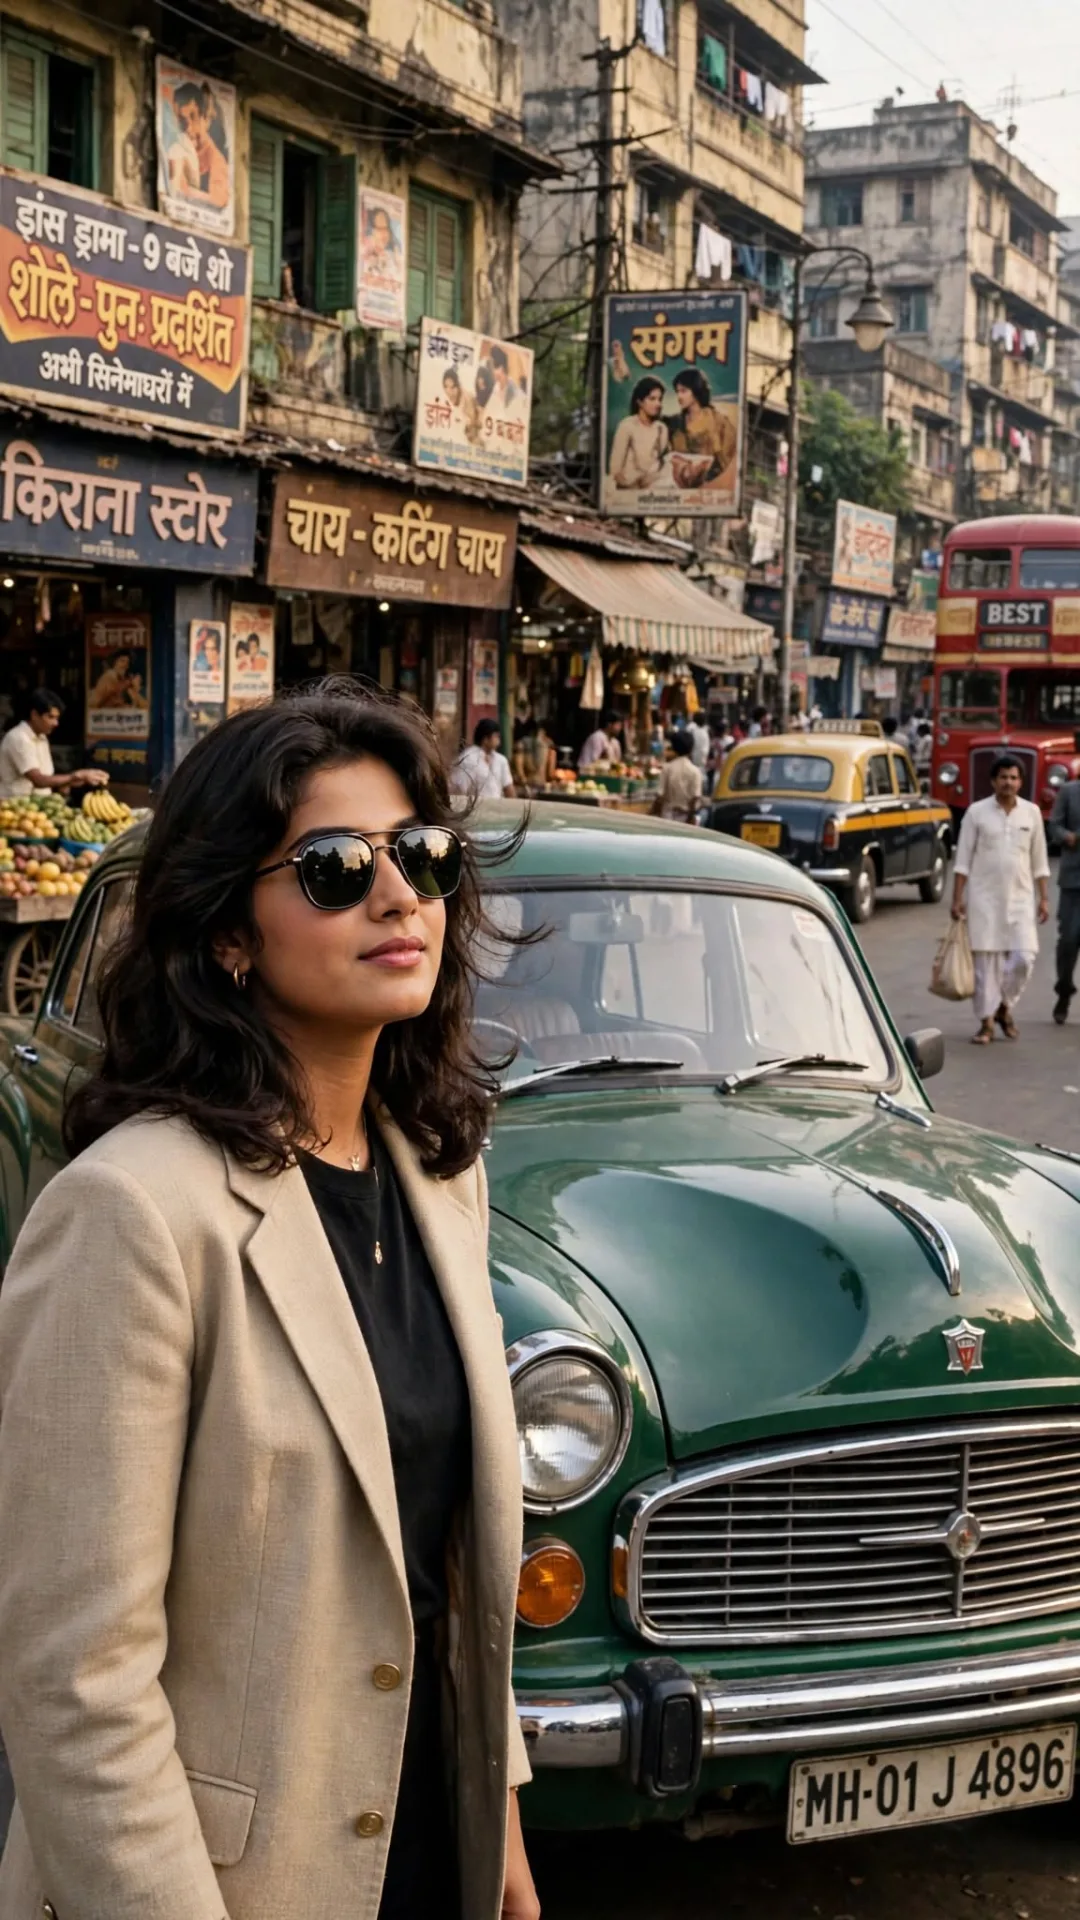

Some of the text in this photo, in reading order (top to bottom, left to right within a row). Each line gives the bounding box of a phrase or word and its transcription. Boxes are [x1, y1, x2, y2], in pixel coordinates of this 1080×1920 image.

[165, 236, 202, 282] बजे
[206, 248, 234, 293] शो
[150, 289, 236, 365] प्रदर्शित
[629, 312, 732, 368] संगम
[39, 346, 195, 409] अभी सिनेमाघरों में
[0, 440, 233, 550] किराना स्टोर
[286, 498, 351, 558] चाय
[371, 500, 453, 571] कटिंग
[455, 526, 507, 578] चाय
[986, 602, 1045, 625] BEST
[805, 1738, 1066, 1828] MH-01 J 4896
